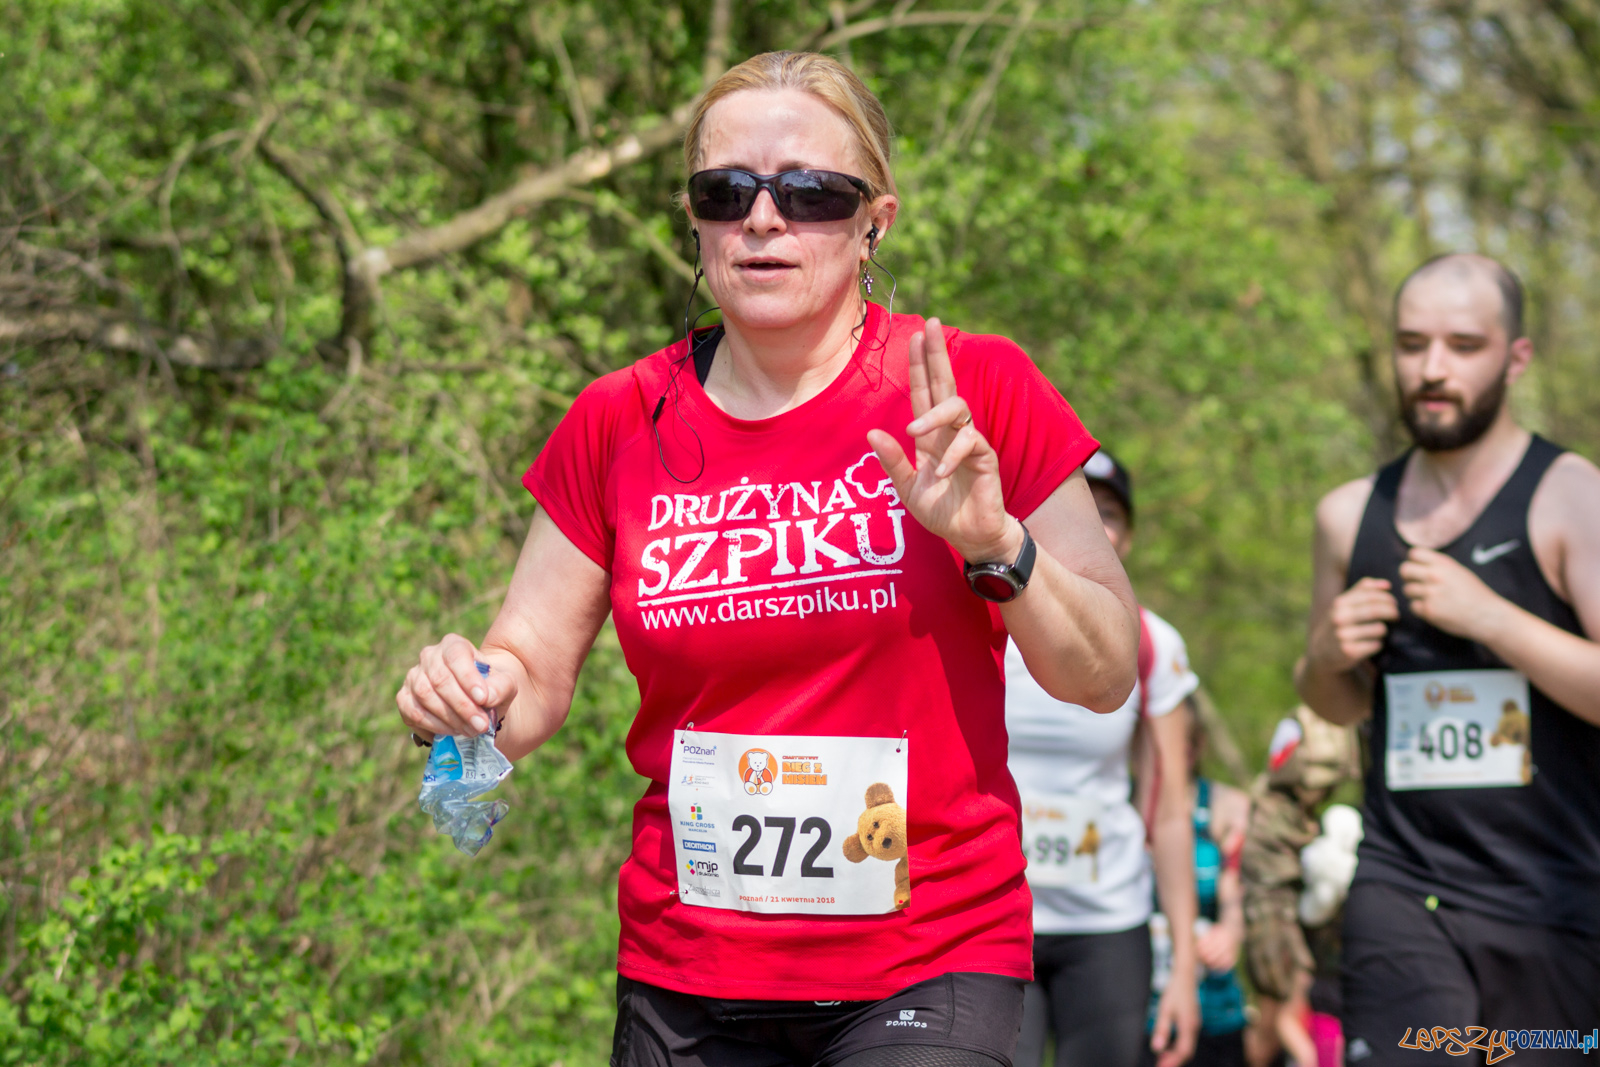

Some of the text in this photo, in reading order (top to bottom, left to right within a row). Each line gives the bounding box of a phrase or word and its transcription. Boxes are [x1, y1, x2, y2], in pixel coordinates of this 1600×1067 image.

[647, 476, 857, 532] DRUŻYNA
[638, 509, 906, 598] SZPIKU
[641, 582, 898, 631] www.darszpiku.pl
[1419, 722, 1484, 762] 408
[782, 761, 811, 773] BIEG
[782, 773, 828, 786] MISIEM
[684, 841, 715, 851] DECATHLON
[732, 813, 835, 879] 272
[1023, 834, 1071, 866] 99
[697, 860, 719, 873] mjp
[816, 896, 836, 904] 2018
[885, 1020, 928, 1029] DOMYOS
